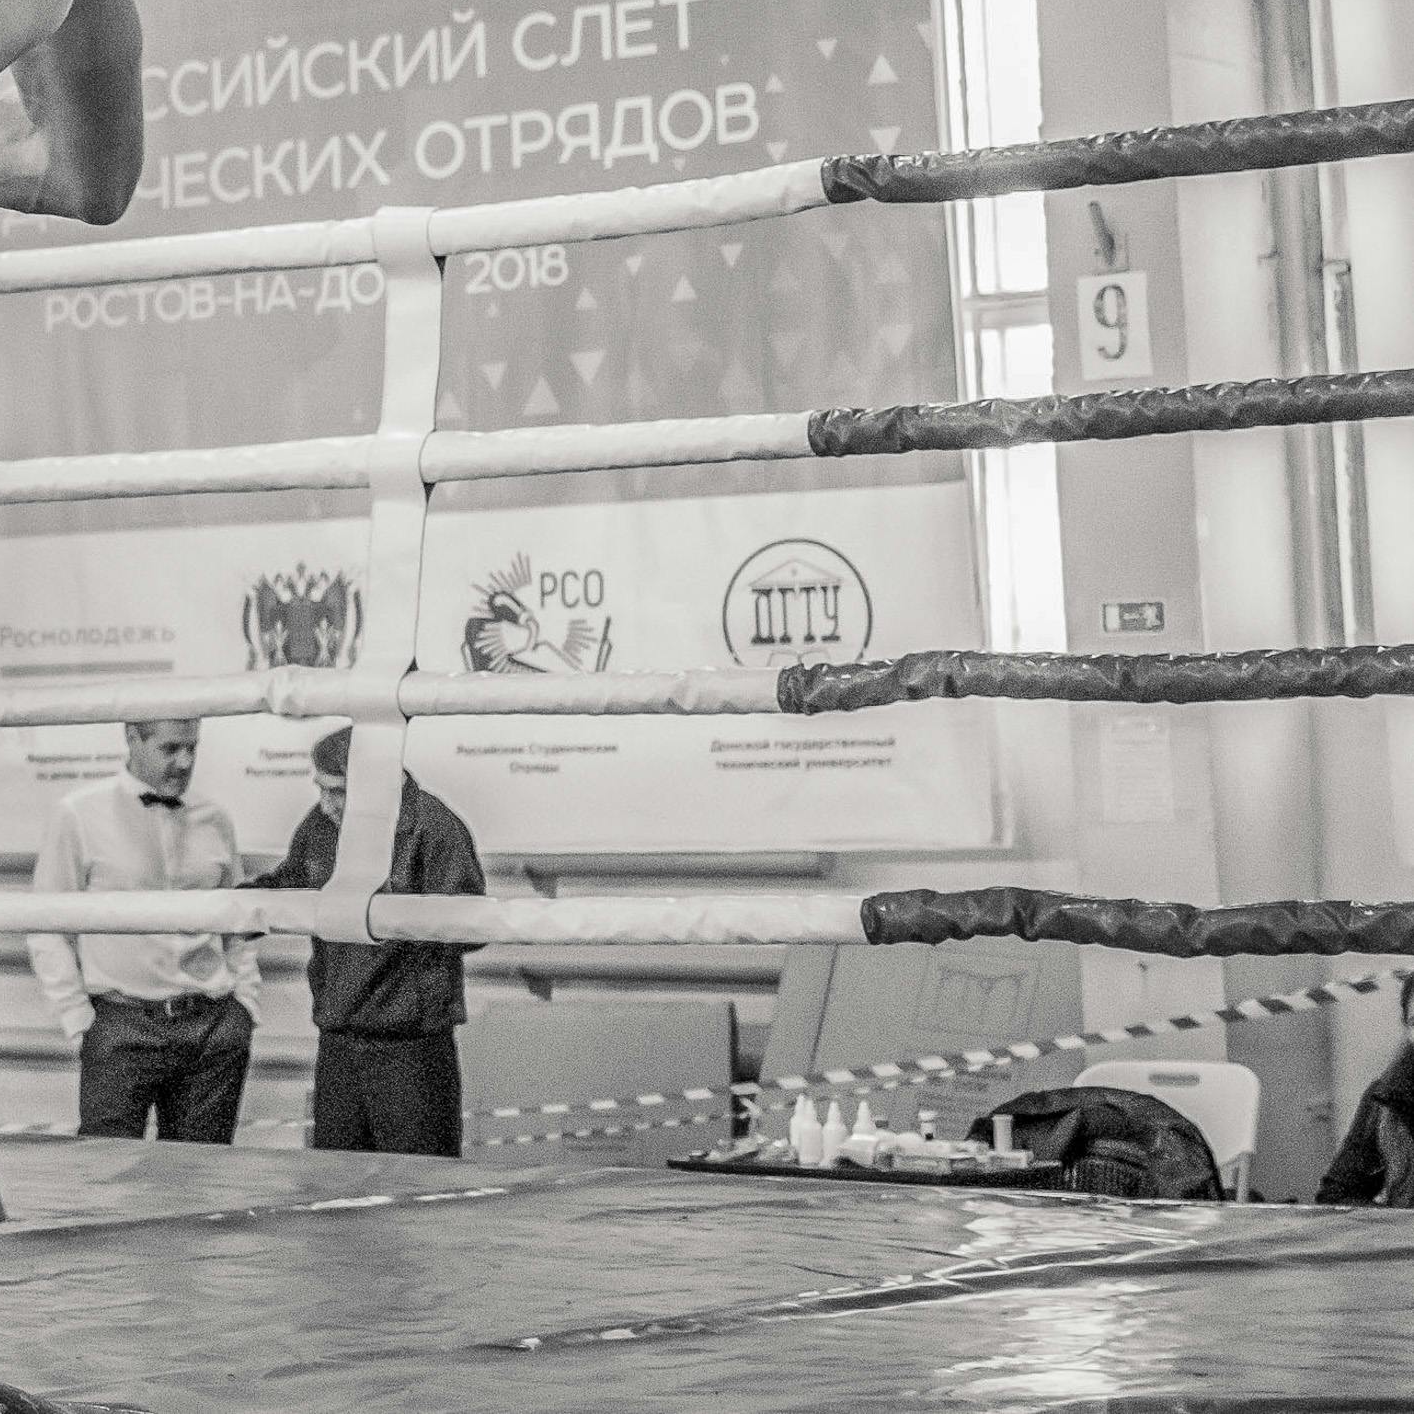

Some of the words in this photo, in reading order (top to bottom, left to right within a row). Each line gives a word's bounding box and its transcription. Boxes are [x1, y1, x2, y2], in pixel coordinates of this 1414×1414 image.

[415, 83, 760, 180] ОТРЯДОВ
[464, 244, 569, 294] 2018
[1092, 283, 1129, 362] 9
[539, 569, 605, 609] РСО
[749, 584, 842, 645] ДГТУ
